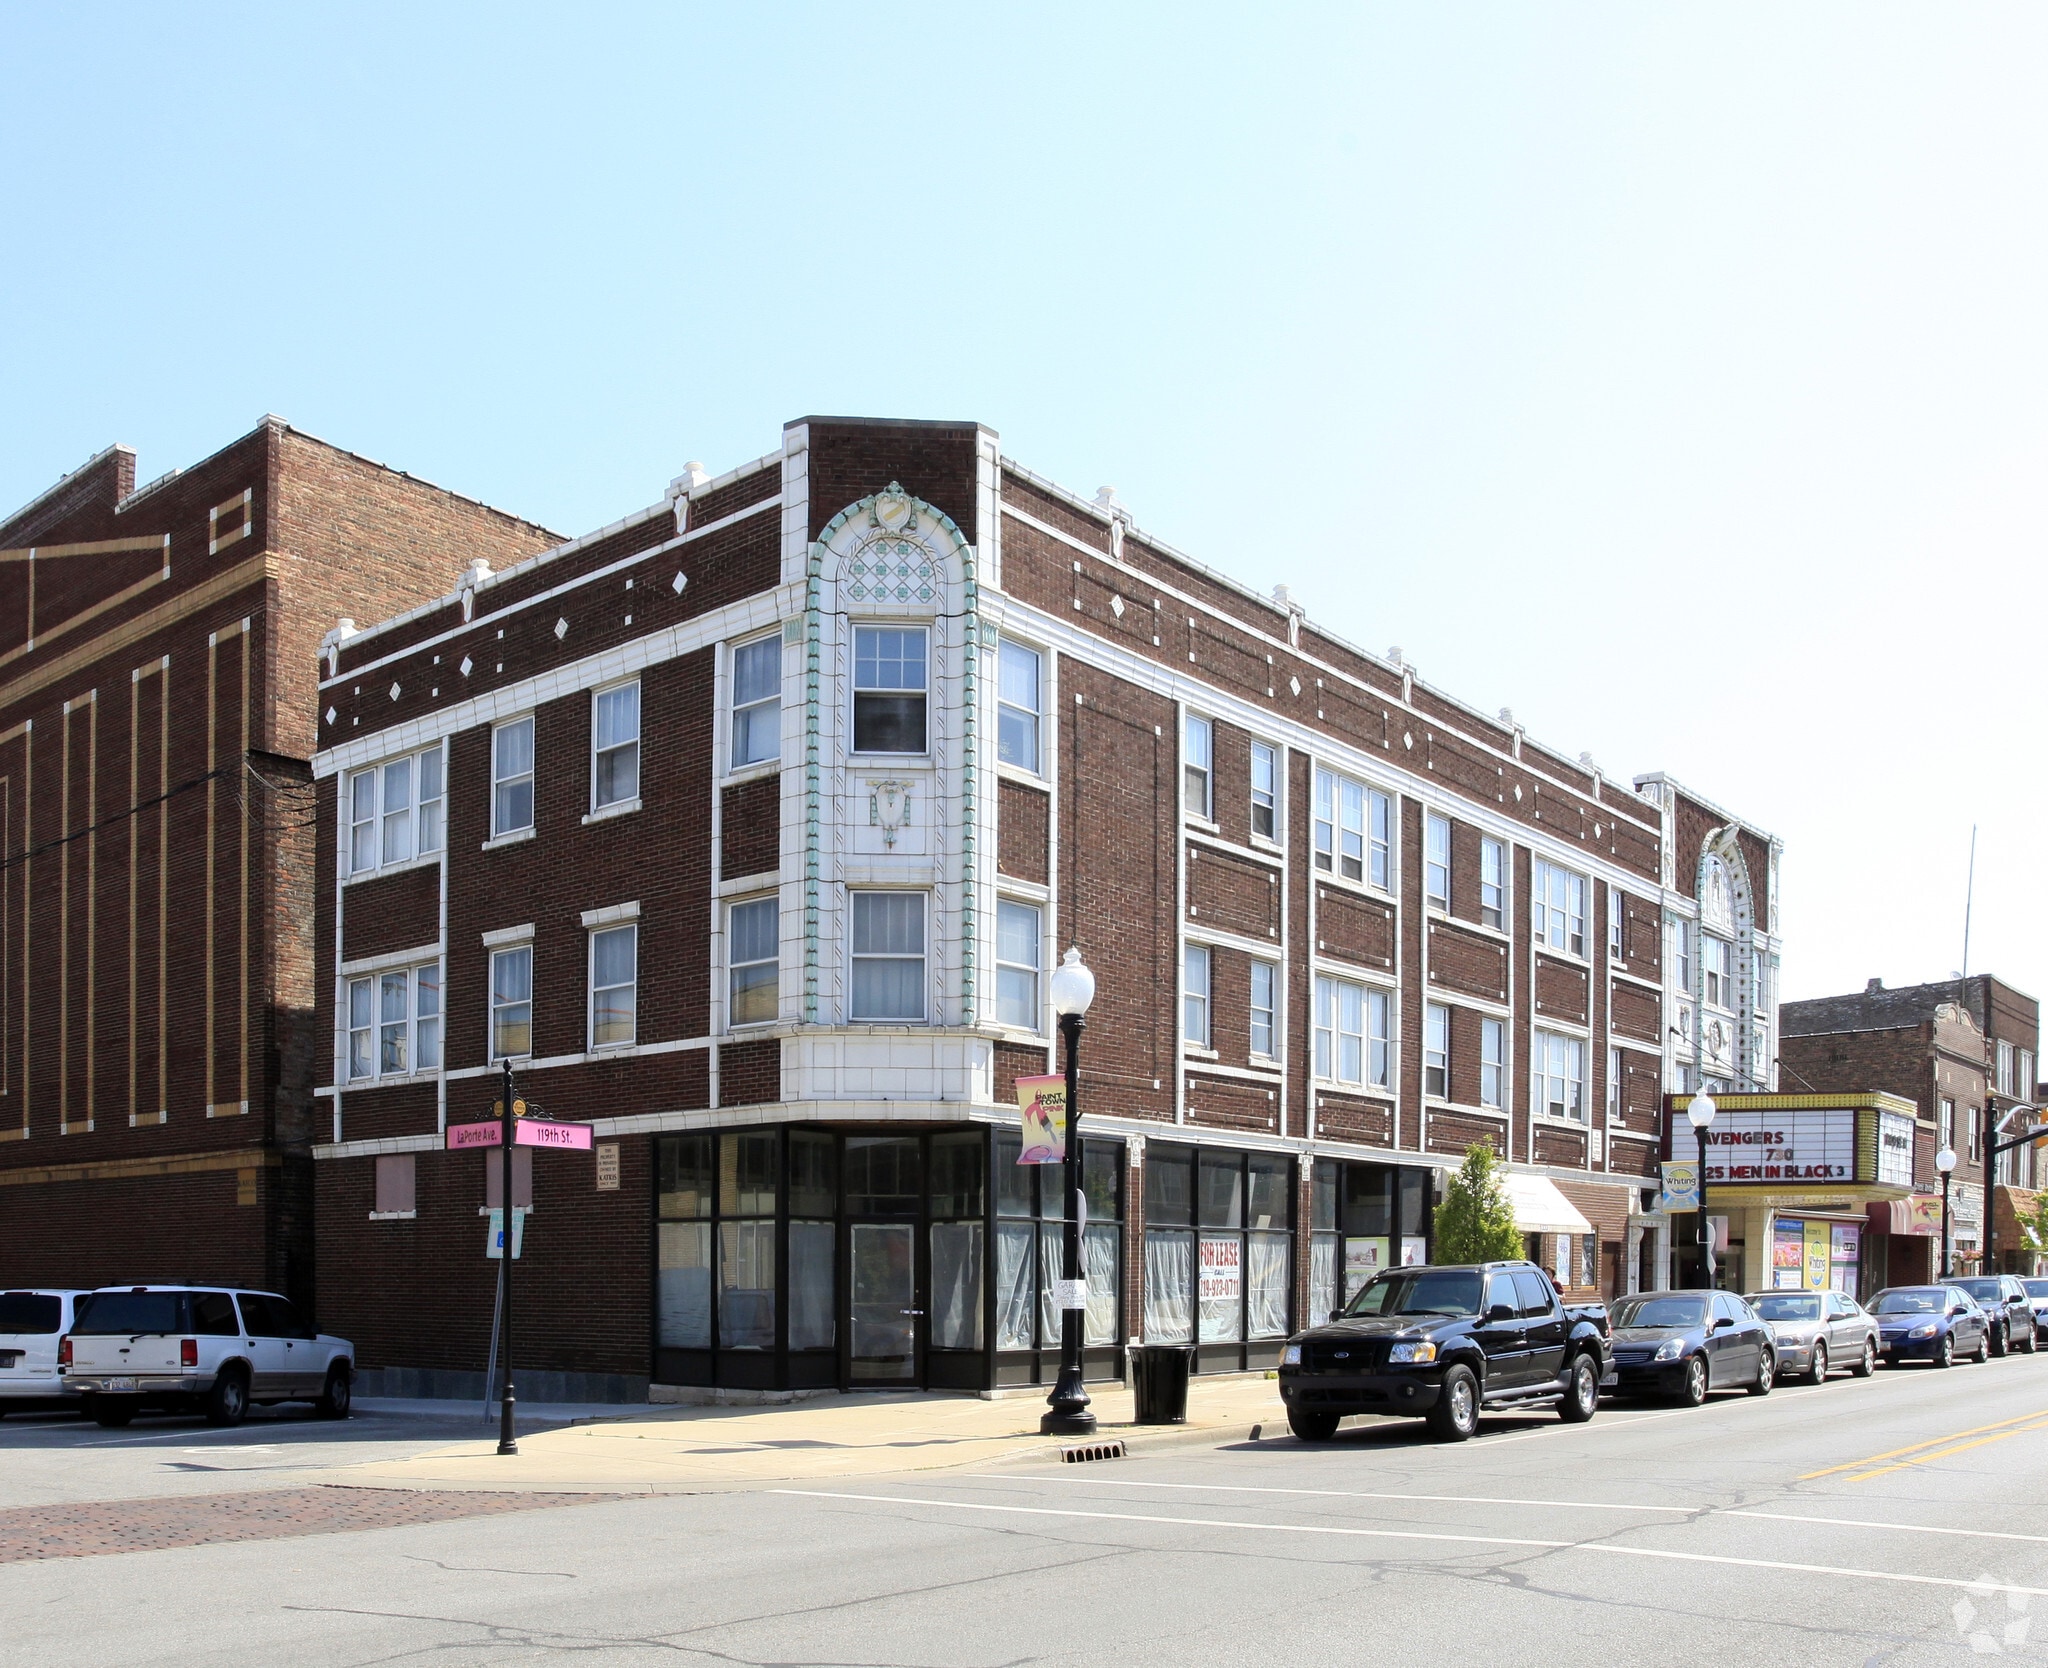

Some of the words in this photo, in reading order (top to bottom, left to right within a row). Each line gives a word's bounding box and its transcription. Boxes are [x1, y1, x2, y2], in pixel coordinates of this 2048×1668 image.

[1040, 1098, 1066, 1106] TOWN
[457, 1129, 481, 1144] LaPorte
[483, 1127, 497, 1141] Ave.
[537, 1127, 559, 1143] 119th
[561, 1129, 573, 1144] St.
[1765, 1148, 1794, 1161] 730
[1729, 1165, 1762, 1179] MEN
[1765, 1164, 1781, 1179] IN
[1784, 1164, 1834, 1178] BLACK
[1836, 1165, 1845, 1177] 3
[1665, 1177, 1697, 1186] Whiting
[1200, 1241, 1215, 1267] FOR
[1215, 1242, 1238, 1267] LEASE
[1808, 1255, 1826, 1272] Whiting
